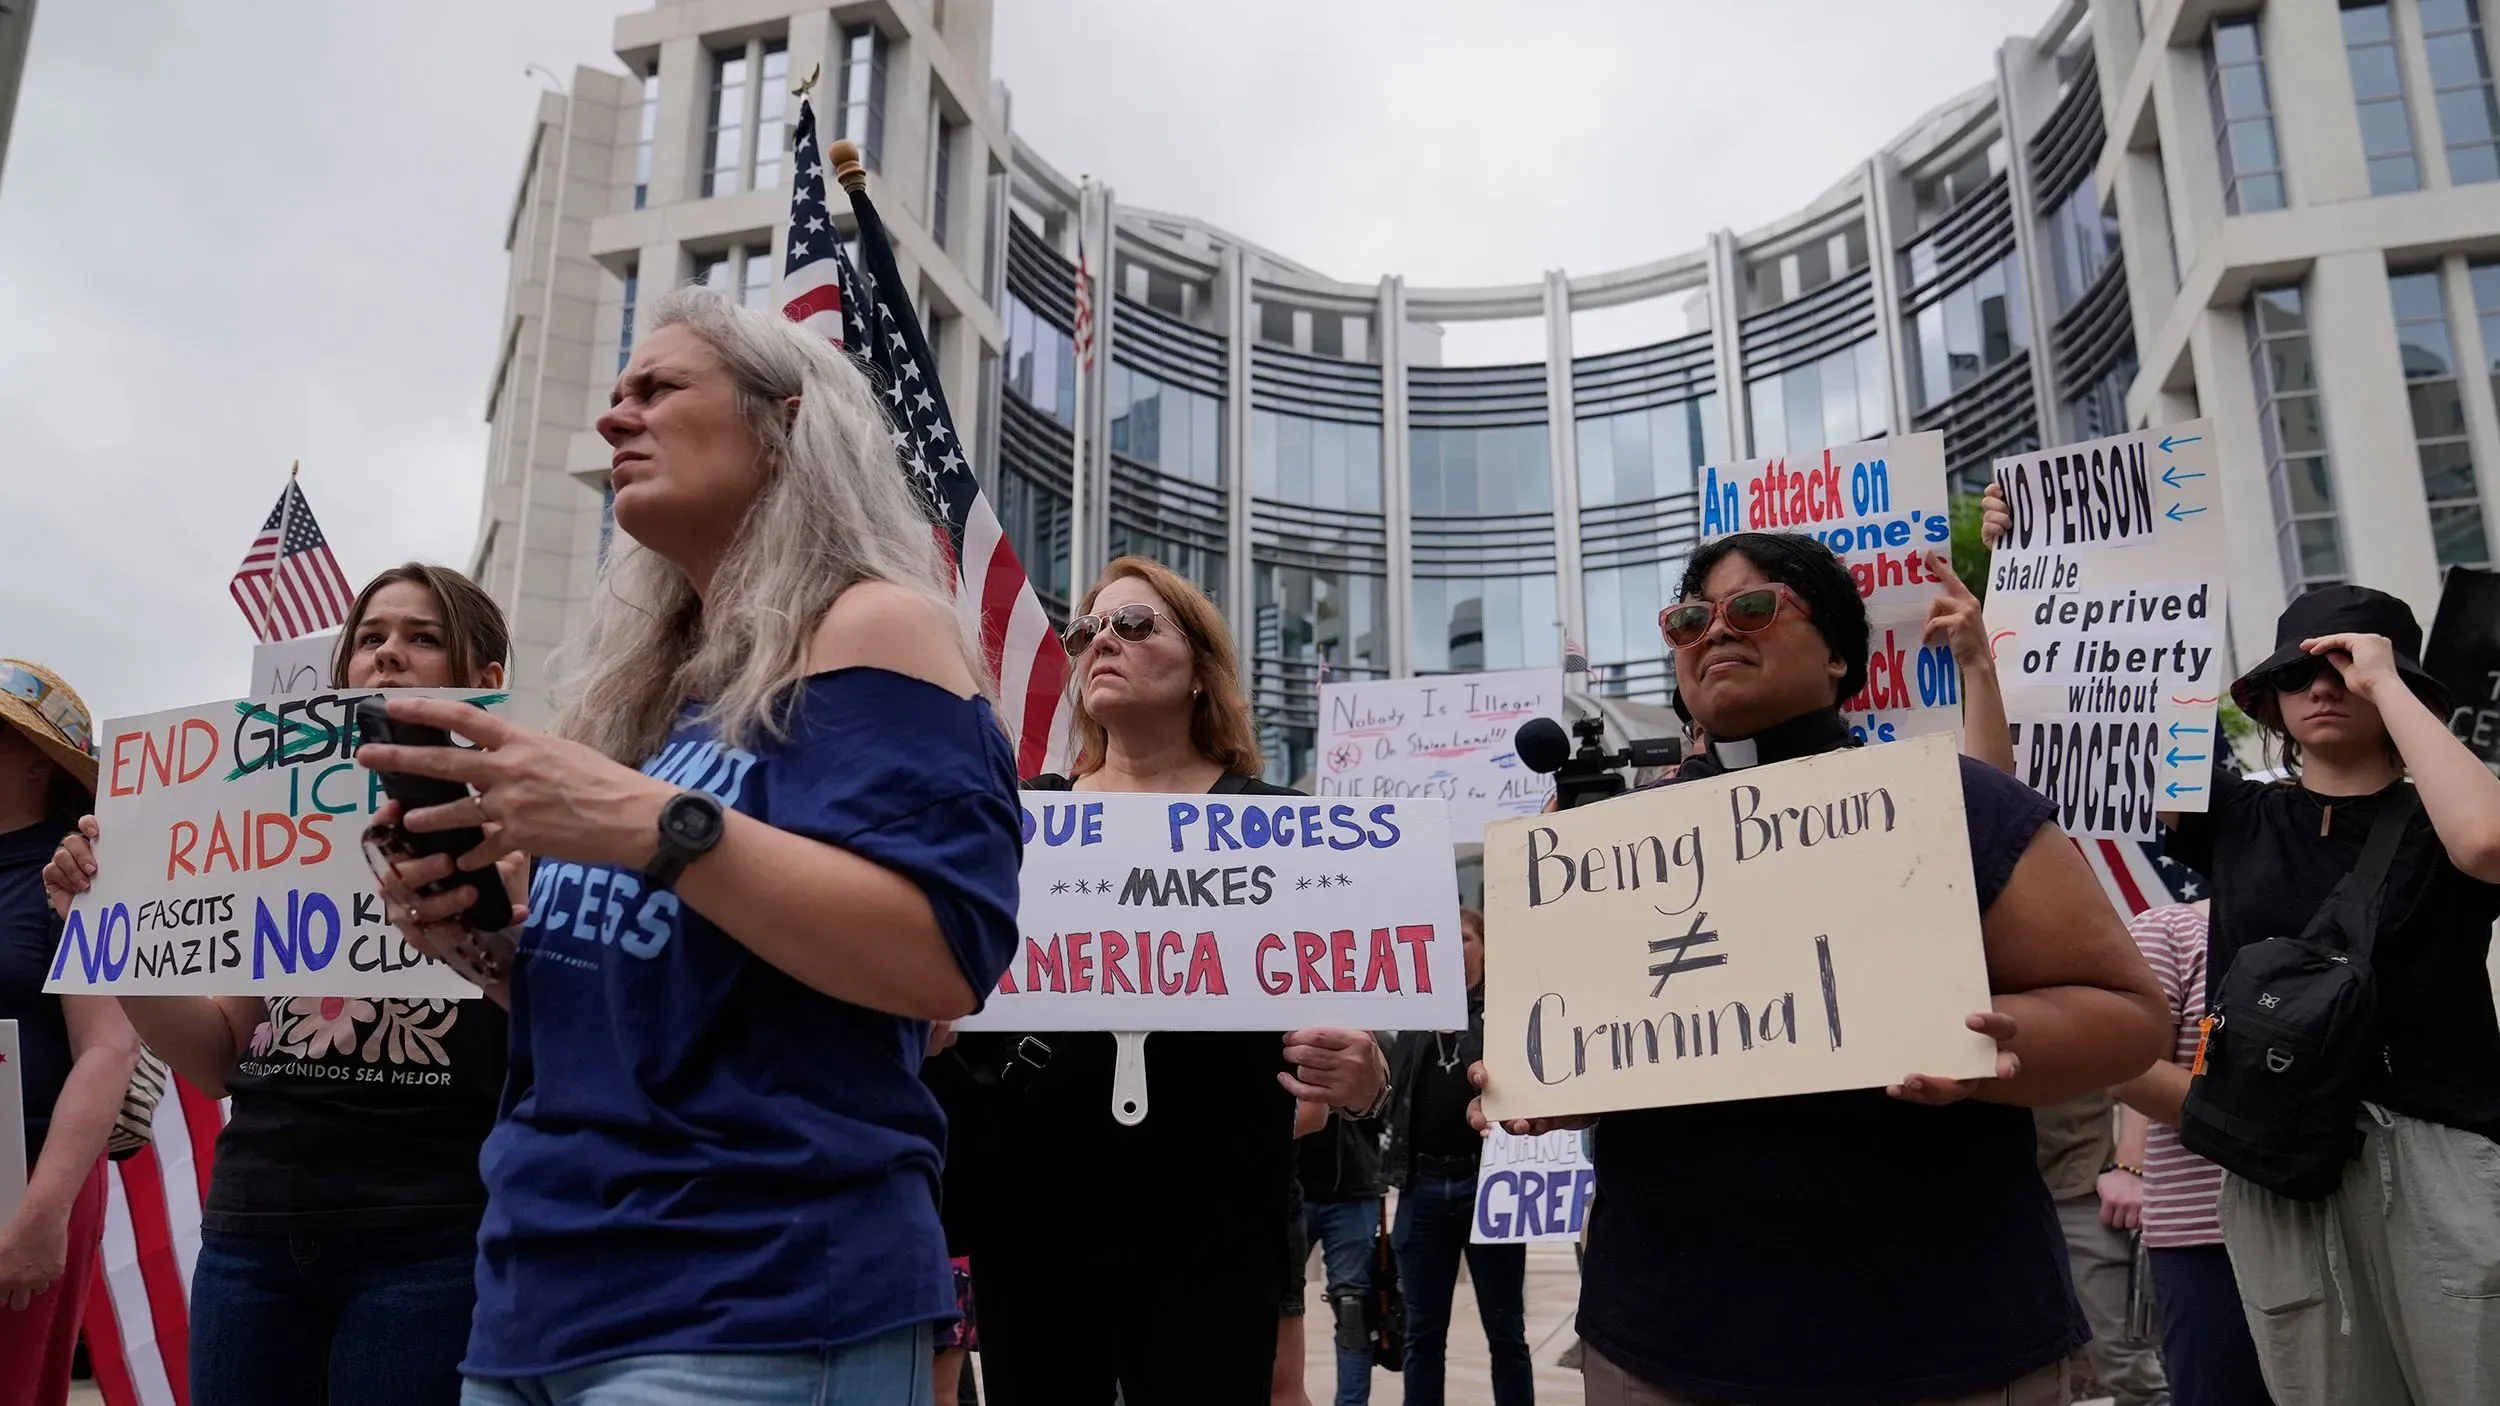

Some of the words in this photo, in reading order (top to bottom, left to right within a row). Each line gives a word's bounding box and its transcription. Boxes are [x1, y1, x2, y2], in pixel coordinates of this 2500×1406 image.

[1703, 467, 1739, 537] An
[1749, 449, 1844, 530] attack
[1852, 459, 1890, 517] on
[1997, 463, 2034, 551] NO
[2039, 442, 2154, 548] PERSON
[1995, 556, 2046, 592] shall
[2052, 554, 2079, 589] be
[2035, 584, 2208, 631] deprived
[1917, 645, 1957, 708] on
[2023, 641, 2061, 674] of
[2073, 640, 2213, 682] liberty
[1332, 694, 1405, 733] Nobody
[1421, 688, 1446, 718] Is
[1463, 683, 1541, 714] Illegal
[2069, 676, 2159, 714] without
[110, 718, 219, 797] END
[1375, 737, 1398, 761] On
[1321, 777, 1364, 799] DUE
[1373, 776, 1459, 800] PROCESS
[2029, 722, 2159, 834] PROCESS
[167, 810, 334, 882] RAIDS
[1168, 802, 1401, 852] PROCESS
[1528, 827, 1705, 915] Being
[1730, 785, 1895, 863] Brown
[1118, 866, 1276, 907] MAKES
[50, 902, 130, 985] NO
[135, 893, 235, 932] FASCITS
[253, 889, 341, 980] NO
[134, 929, 242, 979] NAZIS
[1255, 924, 1435, 996] GREAT
[1526, 934, 1842, 1085] Criminal
[285, 1063, 350, 1080] UNIDOS
[355, 1068, 384, 1083] SEA
[391, 1070, 451, 1086] MEJOR
